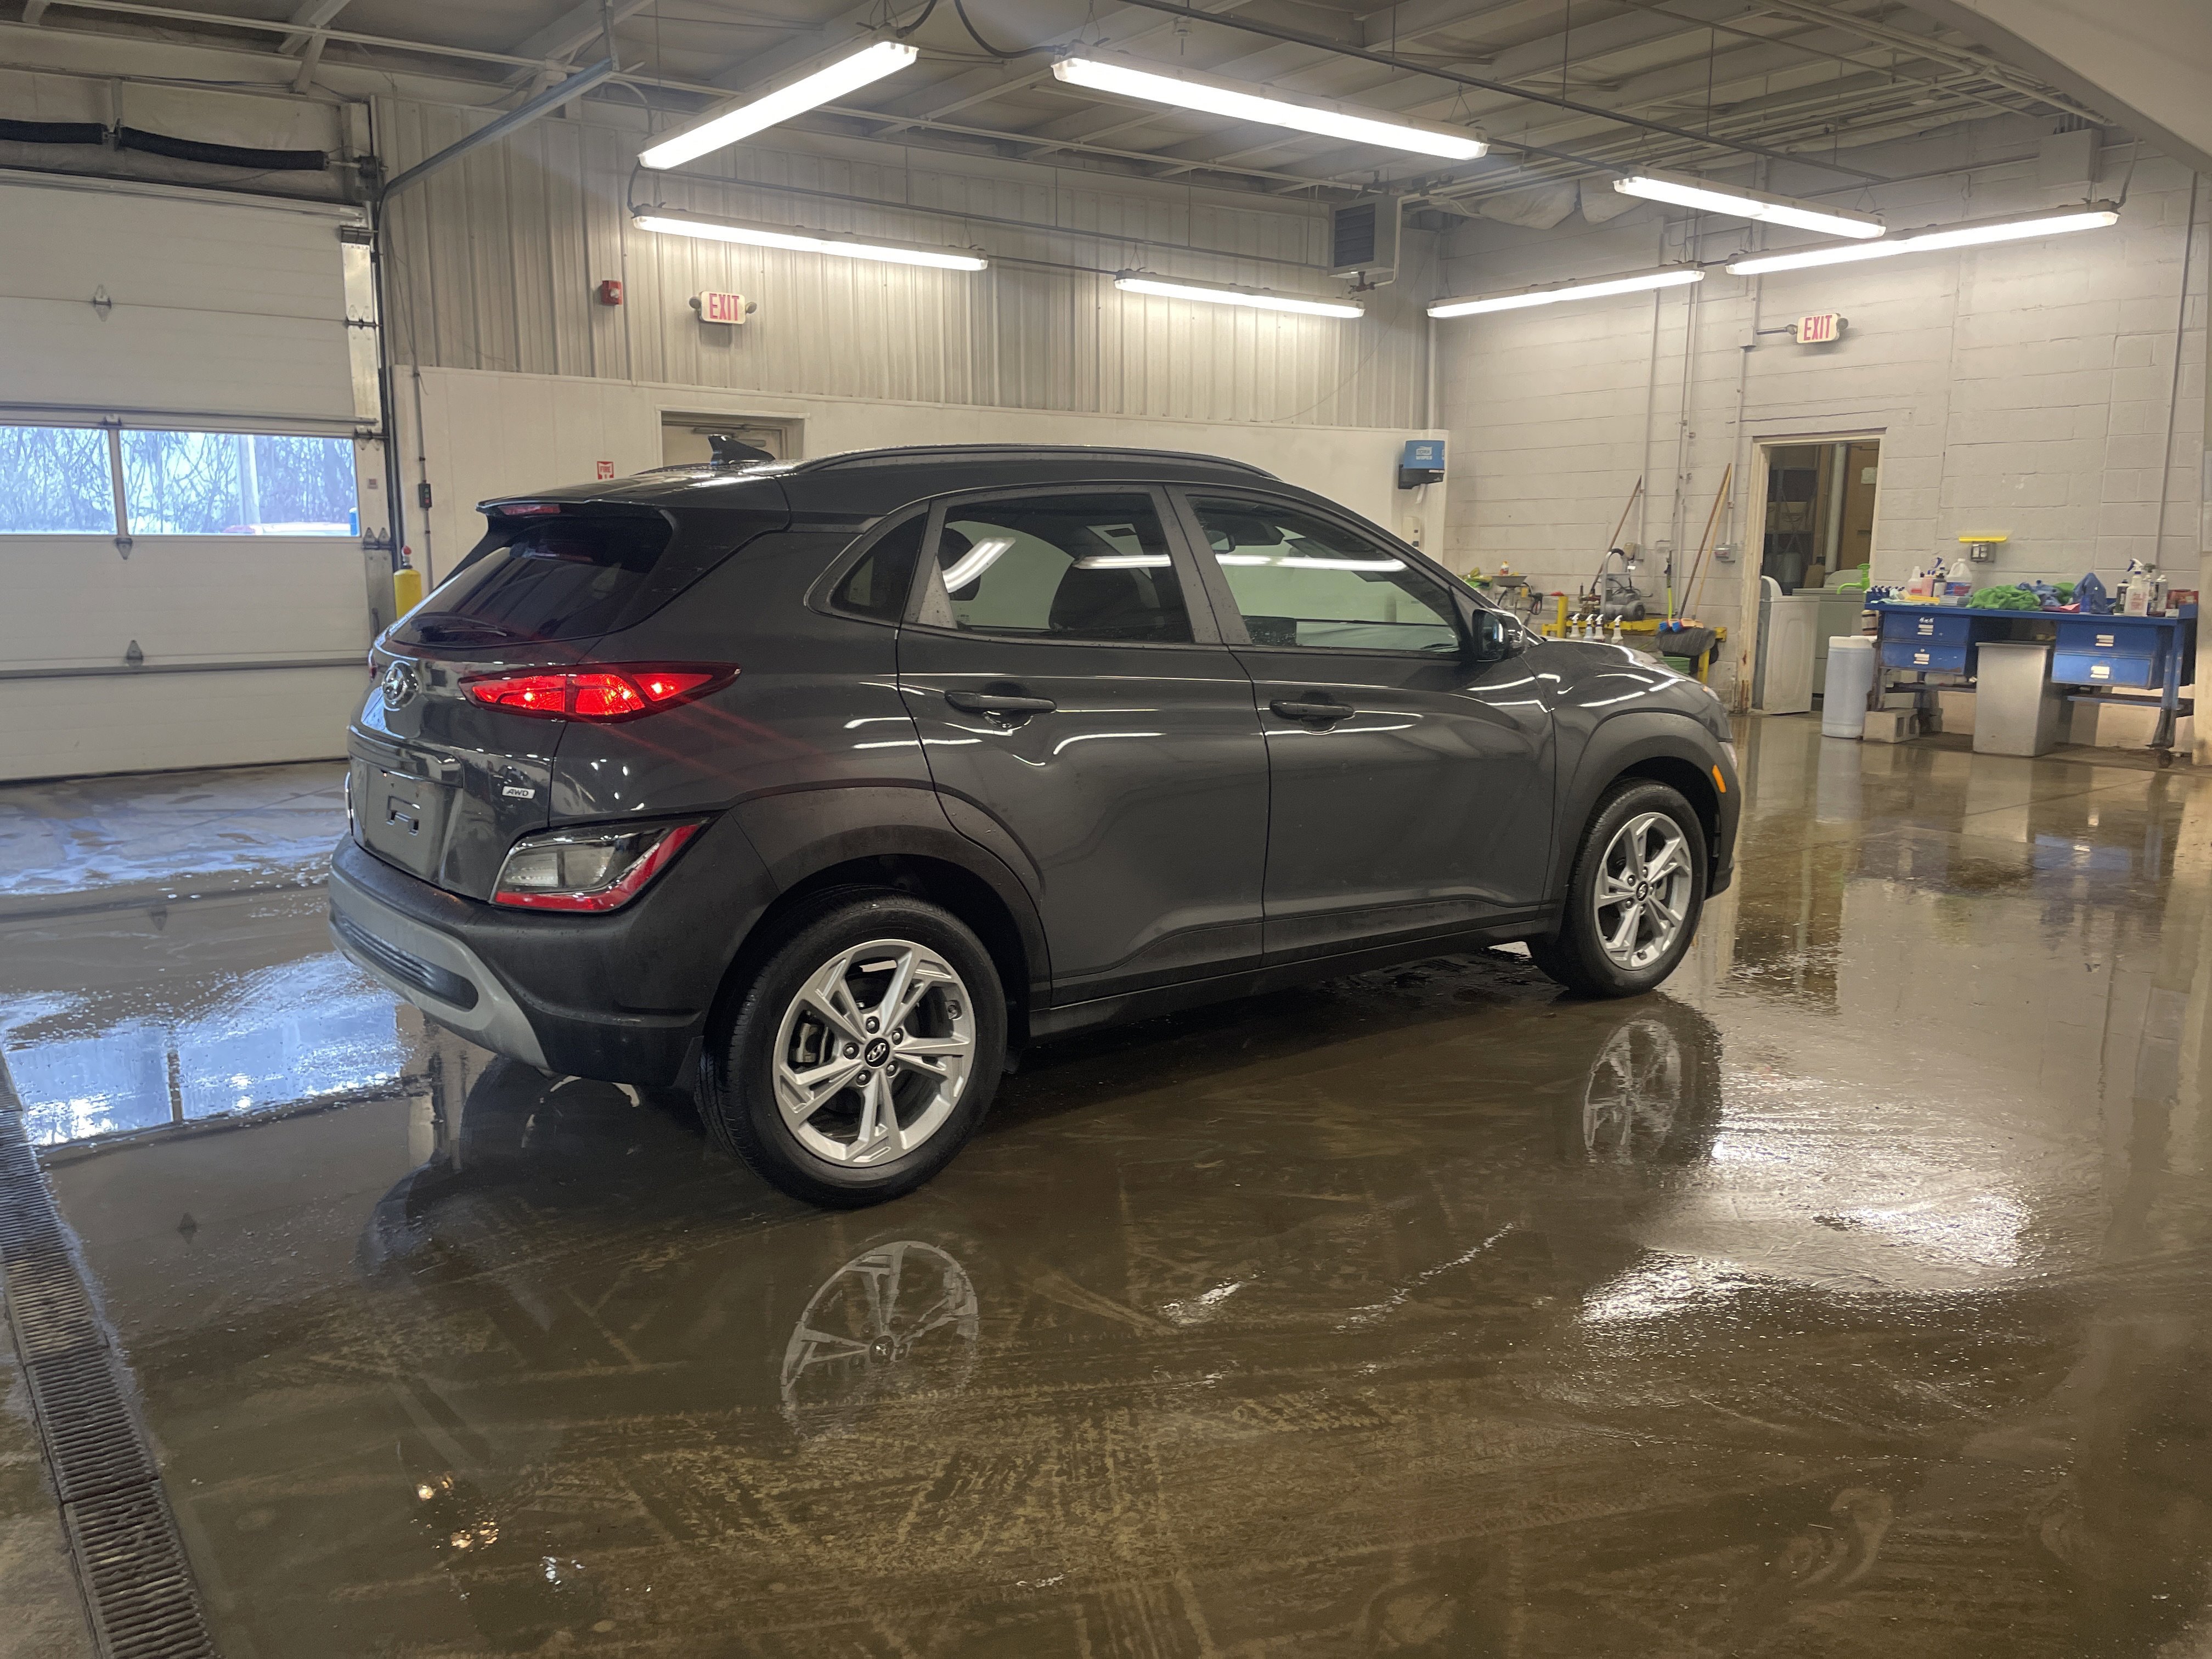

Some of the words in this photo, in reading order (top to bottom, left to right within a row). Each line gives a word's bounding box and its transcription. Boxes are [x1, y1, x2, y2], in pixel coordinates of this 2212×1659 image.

[709, 293, 740, 321] EXIT
[1803, 315, 1833, 341] EXIT
[506, 788, 529, 797] AWD
